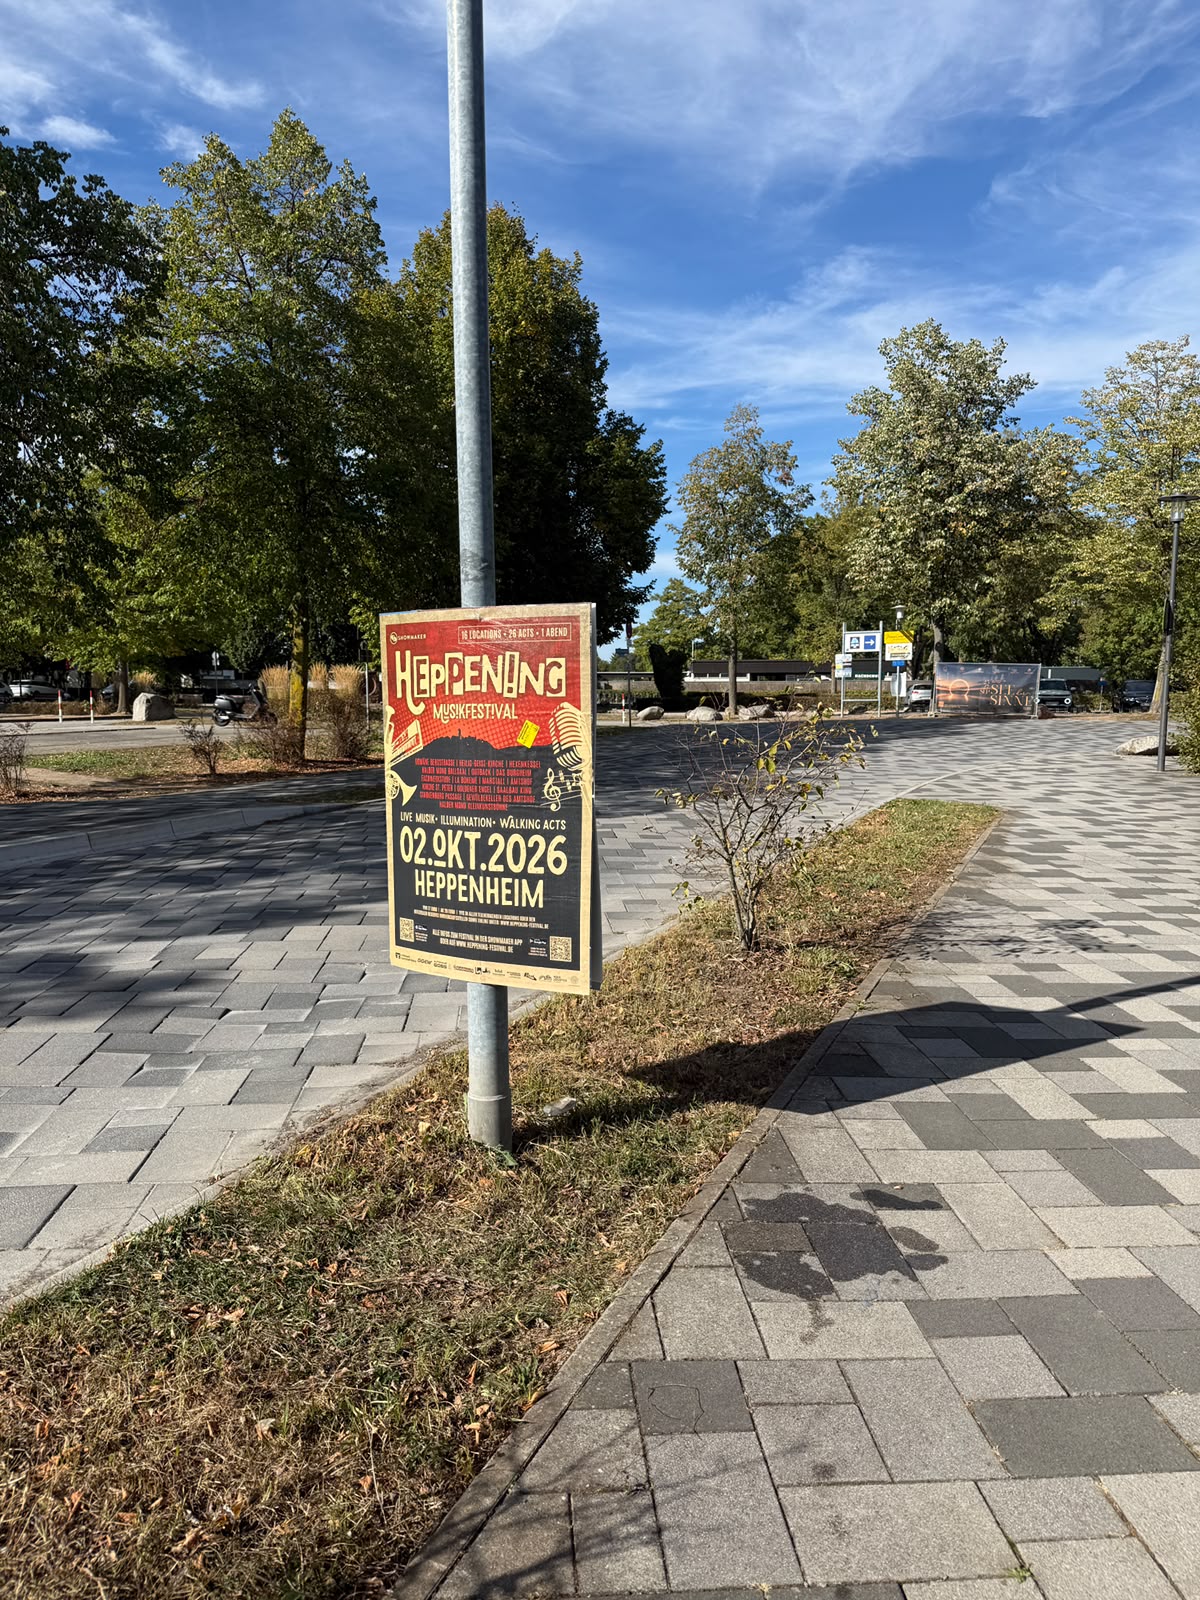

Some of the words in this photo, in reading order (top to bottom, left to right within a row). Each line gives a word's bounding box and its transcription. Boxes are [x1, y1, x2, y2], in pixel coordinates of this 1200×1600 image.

[461, 630, 468, 640] 16
[469, 629, 502, 640] LOCATIONS
[508, 629, 517, 639] 26
[518, 628, 535, 638] ACTS
[546, 627, 568, 637] ABEND
[400, 811, 413, 822] LIVE
[500, 815, 541, 829] WALKING
[543, 820, 567, 830] ACTS
[415, 869, 544, 909] HEPPENHEIM
